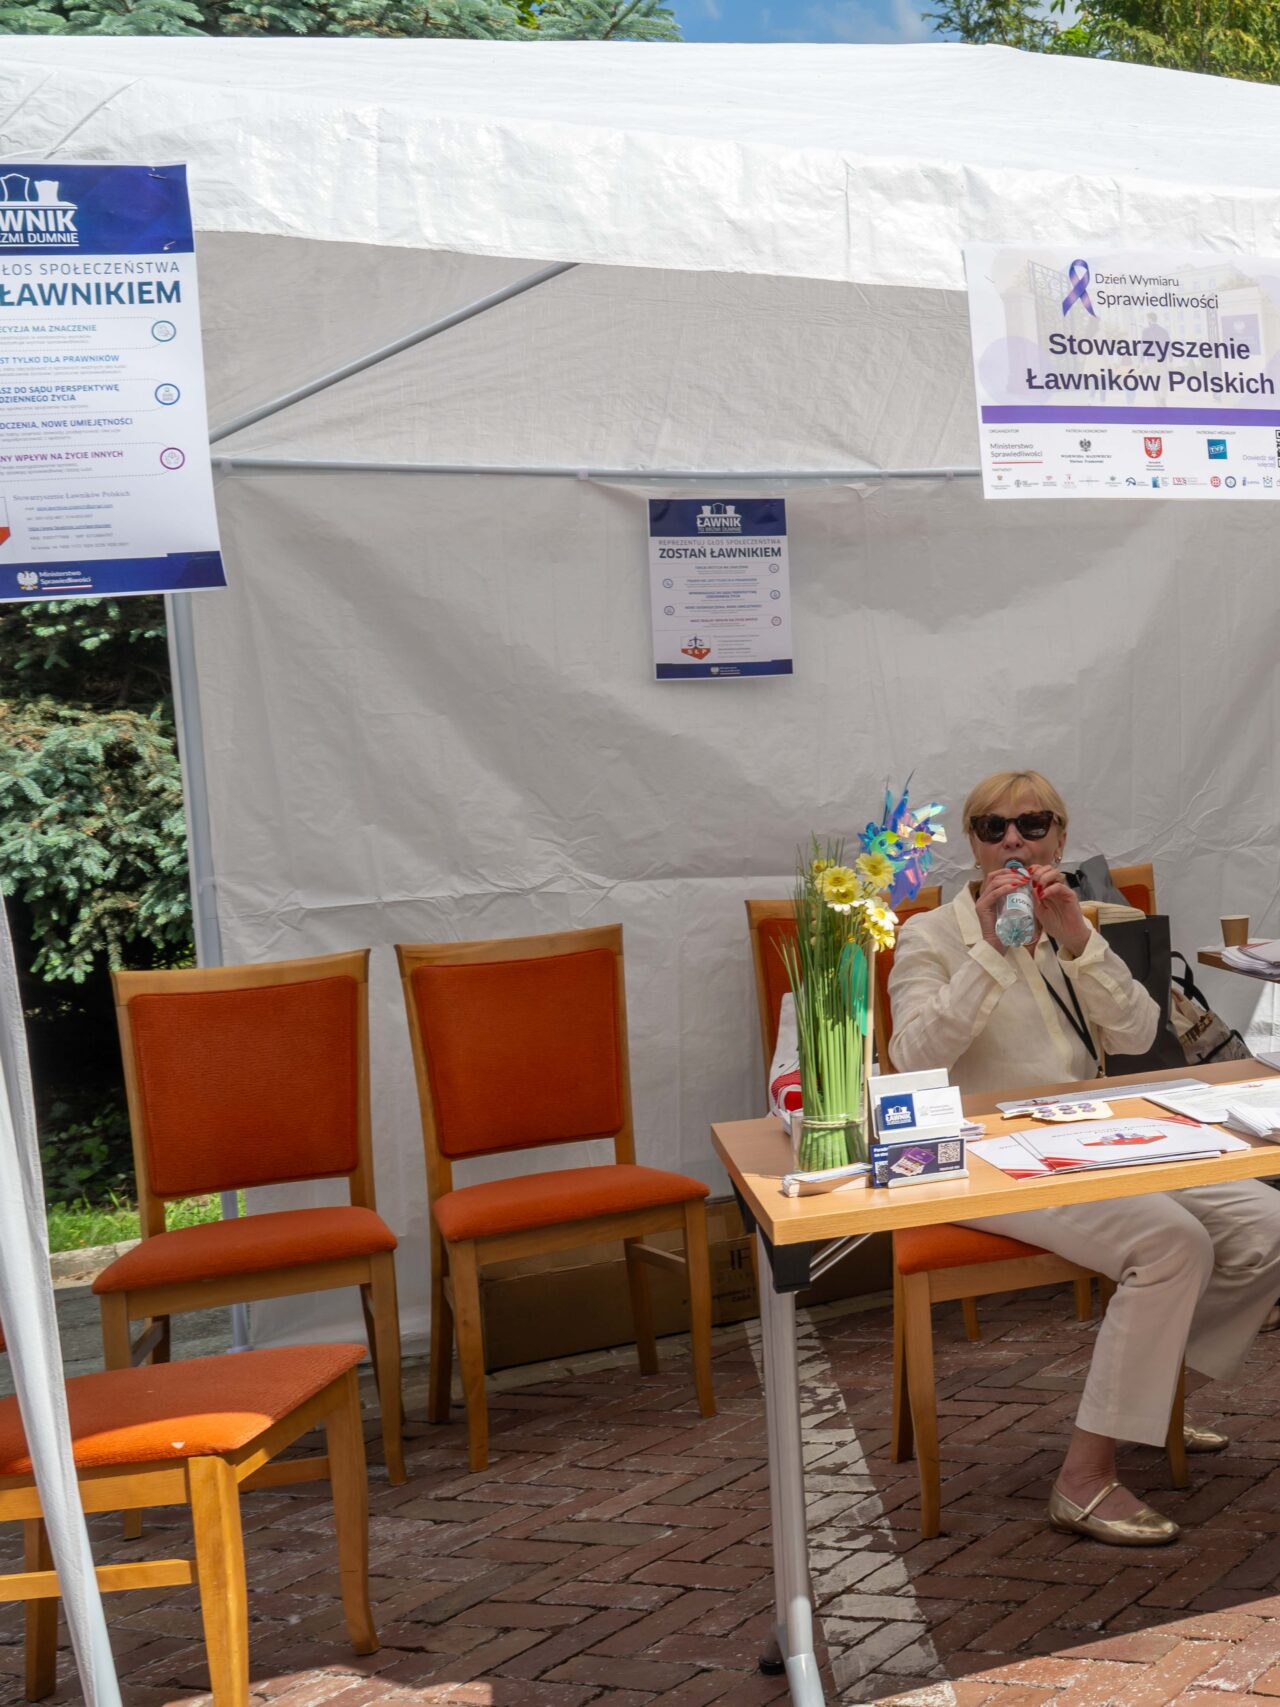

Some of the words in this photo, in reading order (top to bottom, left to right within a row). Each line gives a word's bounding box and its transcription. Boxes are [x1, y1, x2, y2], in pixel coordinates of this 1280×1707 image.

[28, 232, 79, 243] DUMNIE
[40, 260, 180, 275] SPOŁECZEŃSTWA
[1095, 273, 1127, 286] Dzień
[1129, 275, 1179, 288] Wymiaru
[0, 281, 181, 306] ŁAWNIKIEM
[1097, 290, 1219, 310] Sprawiedliwości
[1049, 333, 1250, 362] Stowarzyszenie
[12, 356, 41, 364] TYLKO
[1026, 368, 1161, 393] Ławników
[1169, 371, 1274, 394] Polskich
[14, 386, 27, 394] DO
[41, 420, 68, 428] NOWE
[91, 450, 123, 458] INNYCH
[696, 517, 741, 527] ŁAWNIK
[659, 546, 707, 559] ZOSTAŃ
[710, 547, 782, 558] ŁAWNIKIEM
